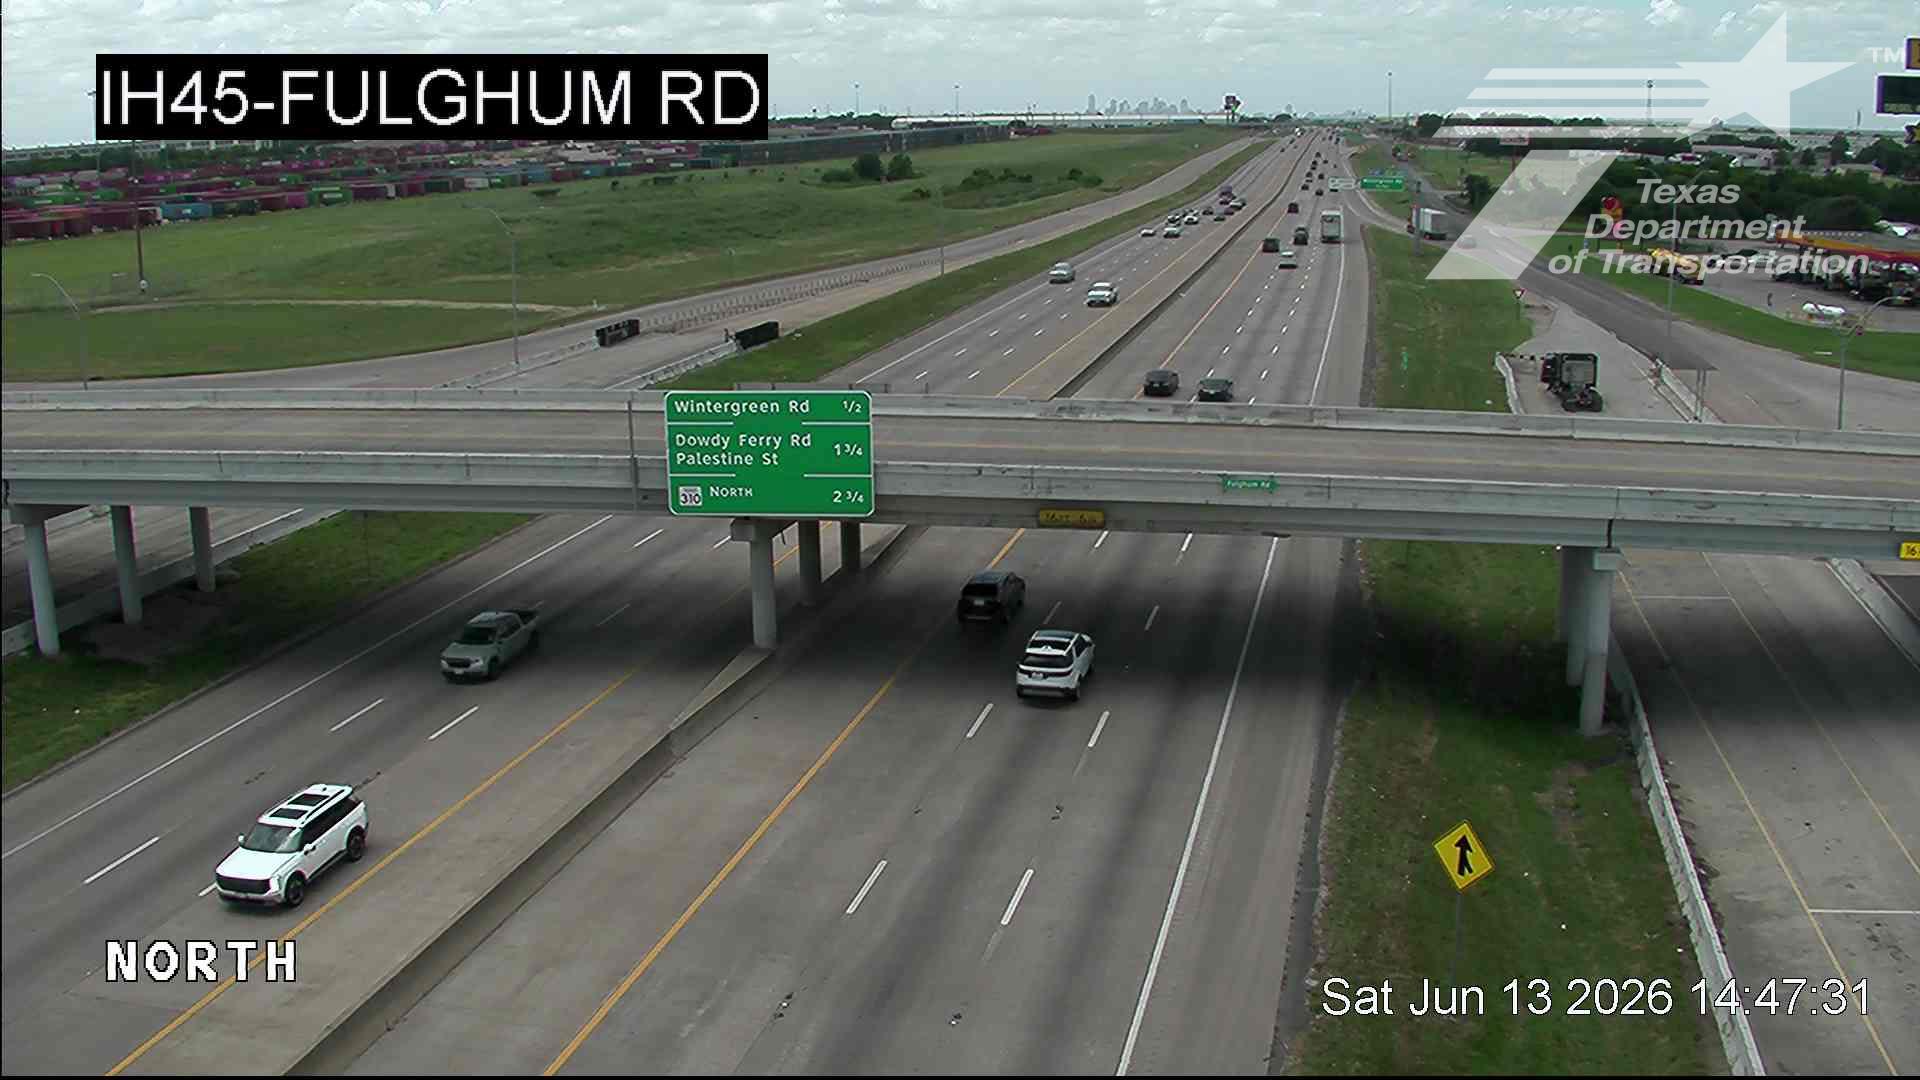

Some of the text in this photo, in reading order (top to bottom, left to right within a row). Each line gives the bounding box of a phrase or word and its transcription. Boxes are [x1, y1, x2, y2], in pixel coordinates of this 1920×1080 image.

[674, 400, 810, 416] Wintergreen Rd
[843, 400, 862, 413] 1/2
[675, 433, 811, 450] Dowdy Ferry Rd
[676, 452, 779, 466] Palestine St
[680, 492, 701, 505] 310
[709, 486, 753, 498] NORTH
